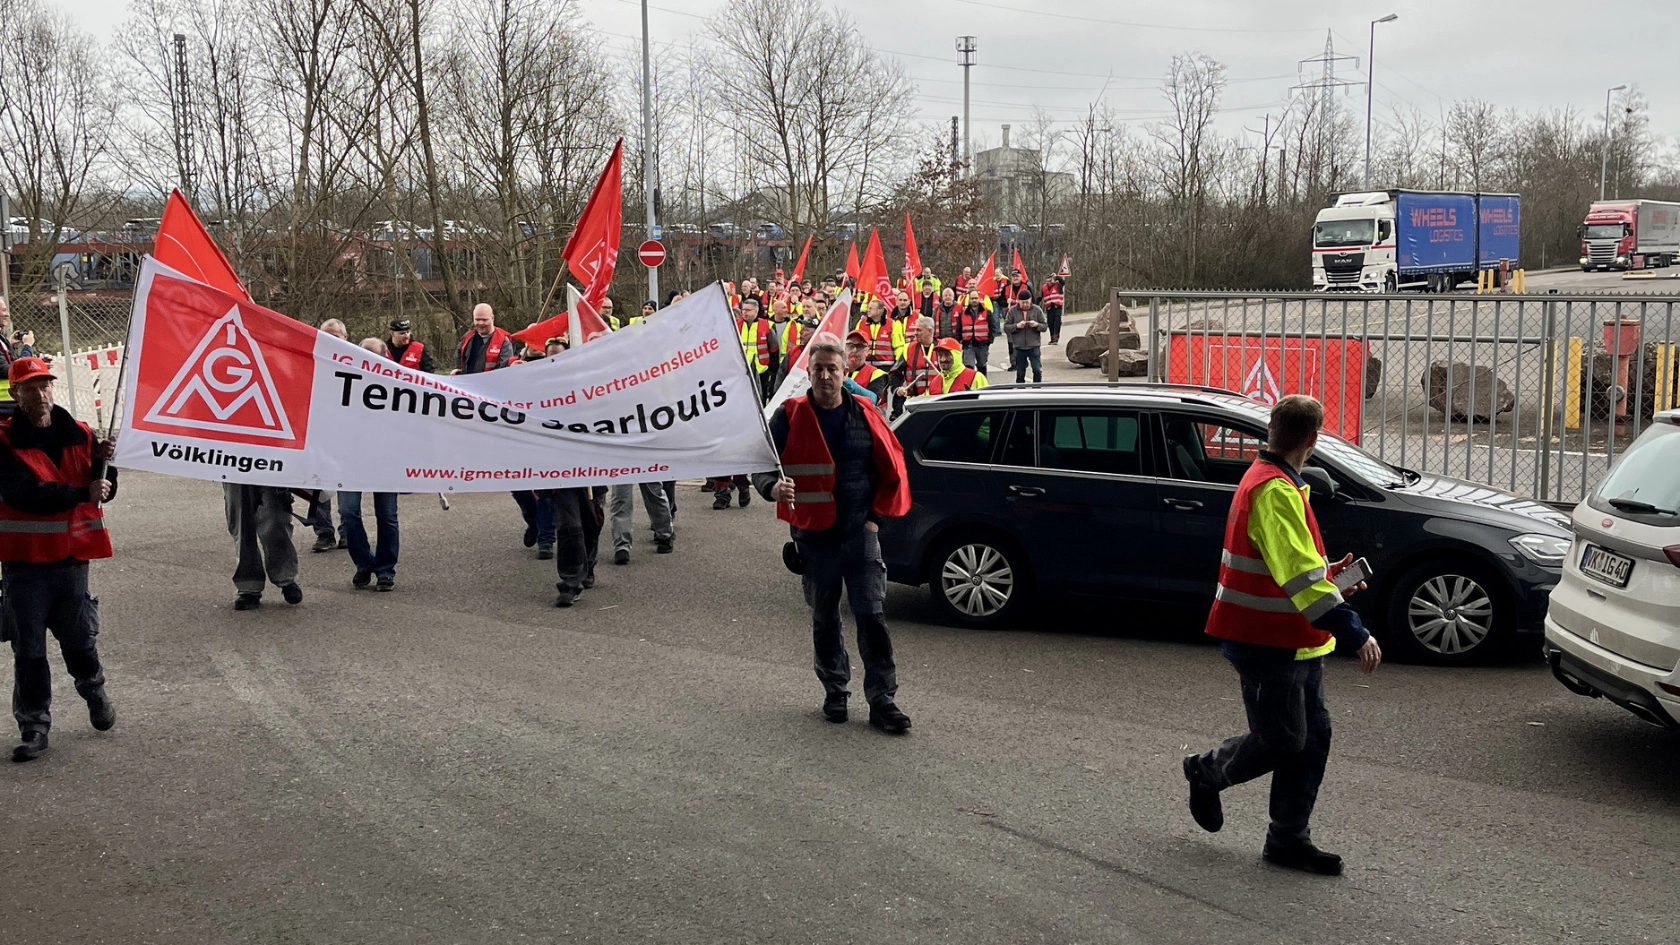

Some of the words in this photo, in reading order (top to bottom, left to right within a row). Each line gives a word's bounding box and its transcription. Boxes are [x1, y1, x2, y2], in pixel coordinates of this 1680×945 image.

[1411, 208, 1457, 227] WHEELS
[1480, 208, 1513, 224] WHEELS
[1430, 229, 1464, 243] LOGISTICS
[540, 390, 577, 408] und
[582, 338, 720, 400] Vertrauensleute
[335, 371, 526, 425] Tenneco
[150, 440, 284, 473] Völklingen
[405, 463, 670, 482] www.igmetall-voelklingen.de
